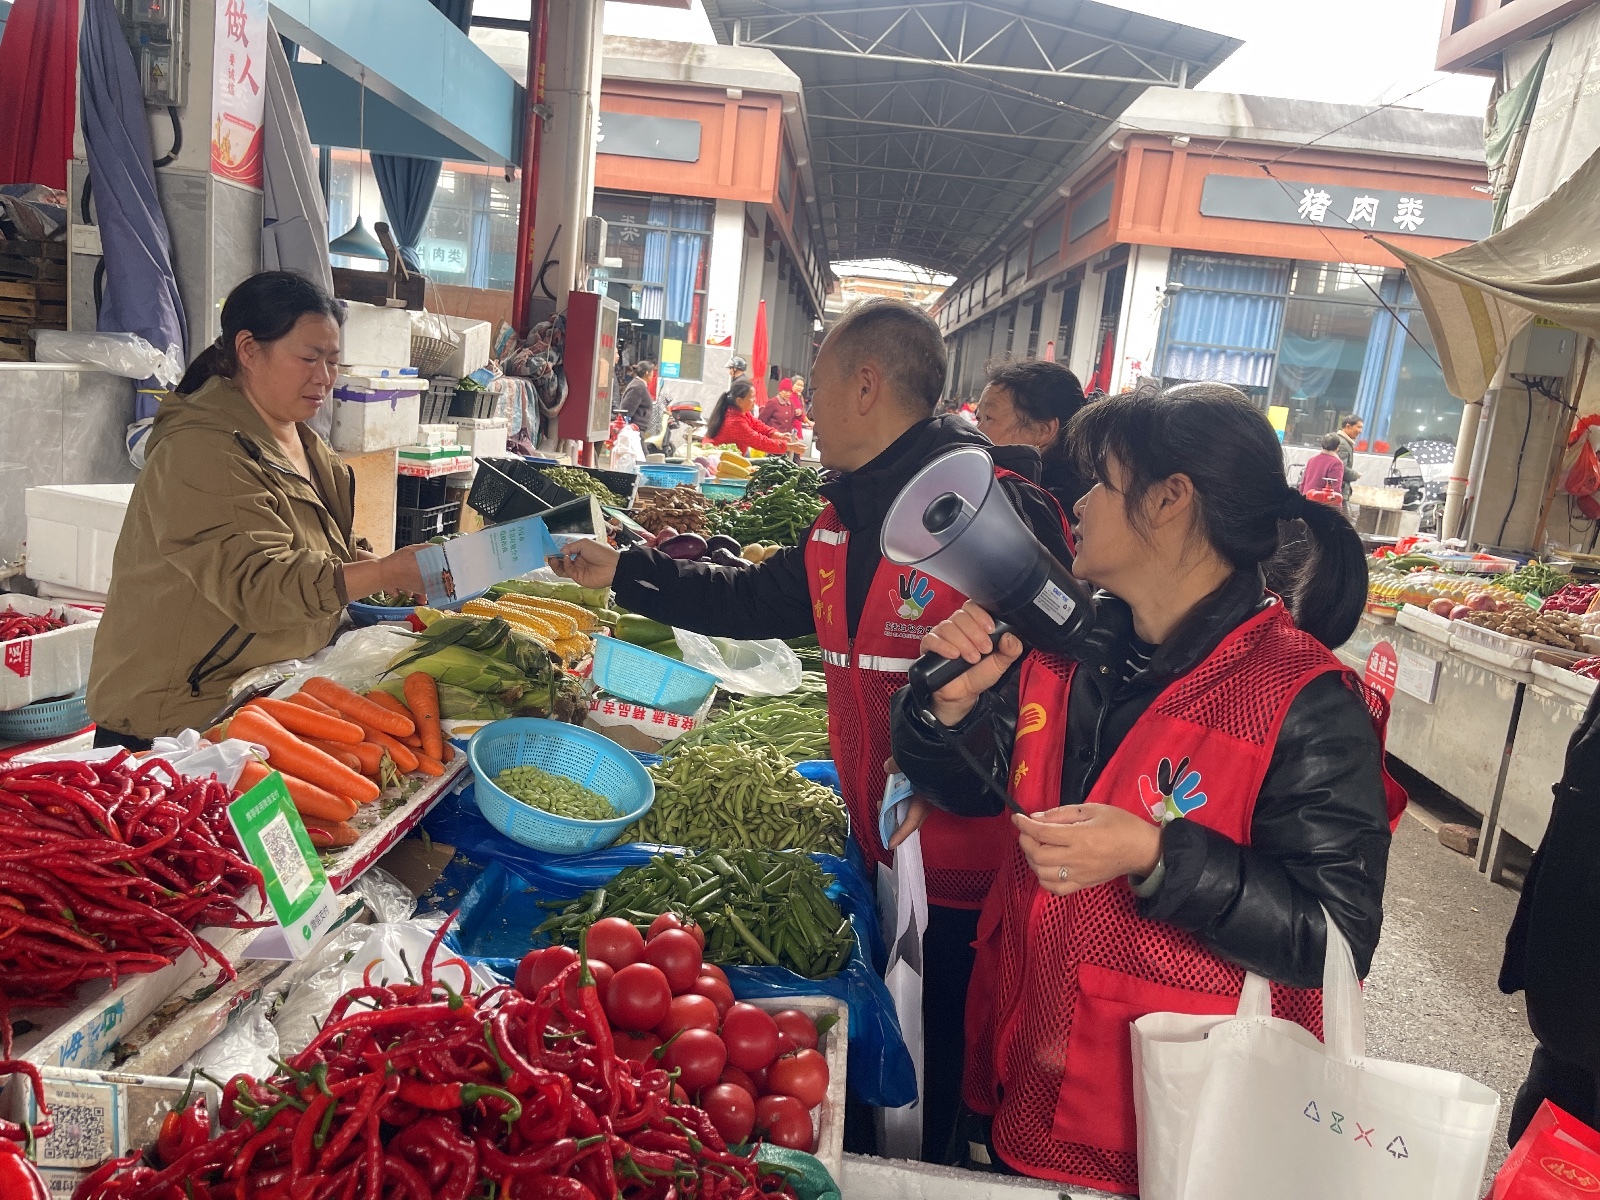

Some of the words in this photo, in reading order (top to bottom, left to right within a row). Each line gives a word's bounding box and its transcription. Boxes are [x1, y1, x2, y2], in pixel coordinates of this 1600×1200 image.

[1297, 187, 1426, 232] 猪肉类
[1369, 651, 1397, 681] 通道三
